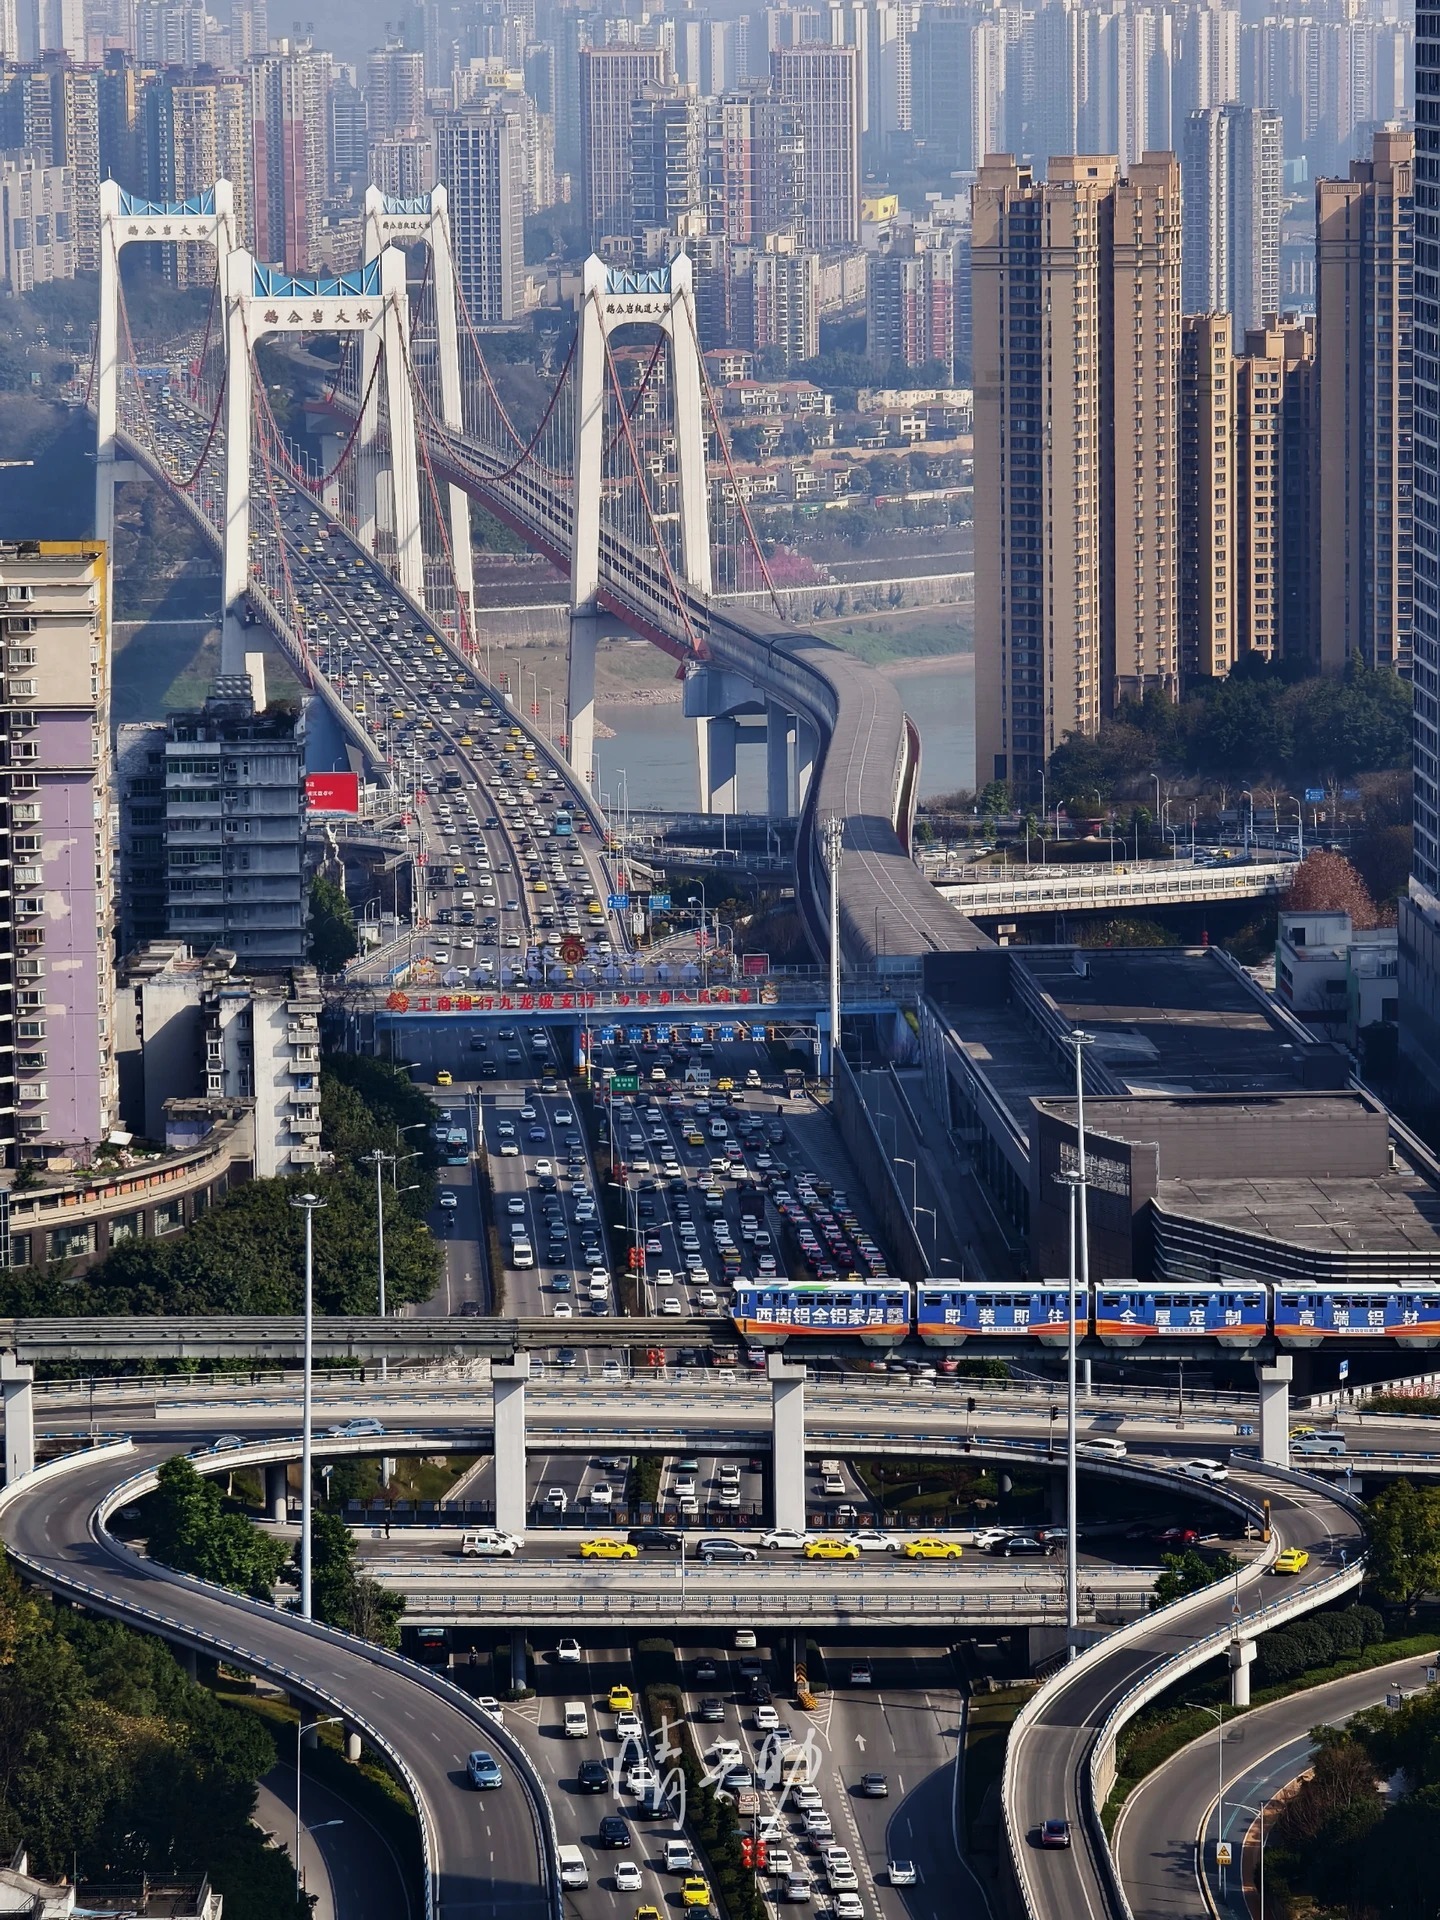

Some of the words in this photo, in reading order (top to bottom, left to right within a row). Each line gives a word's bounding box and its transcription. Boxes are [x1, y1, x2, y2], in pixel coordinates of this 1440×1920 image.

[264, 308, 373, 324] 鹅公岩大桥
[417, 992, 596, 1012] 工商银行九龙坡支行
[755, 1307, 883, 1325] 西南铝全铝家居
[945, 1309, 1064, 1325] 即装即住
[1119, 1309, 1242, 1326] 全屋定制
[1299, 1310, 1420, 1326] 高端铝材
